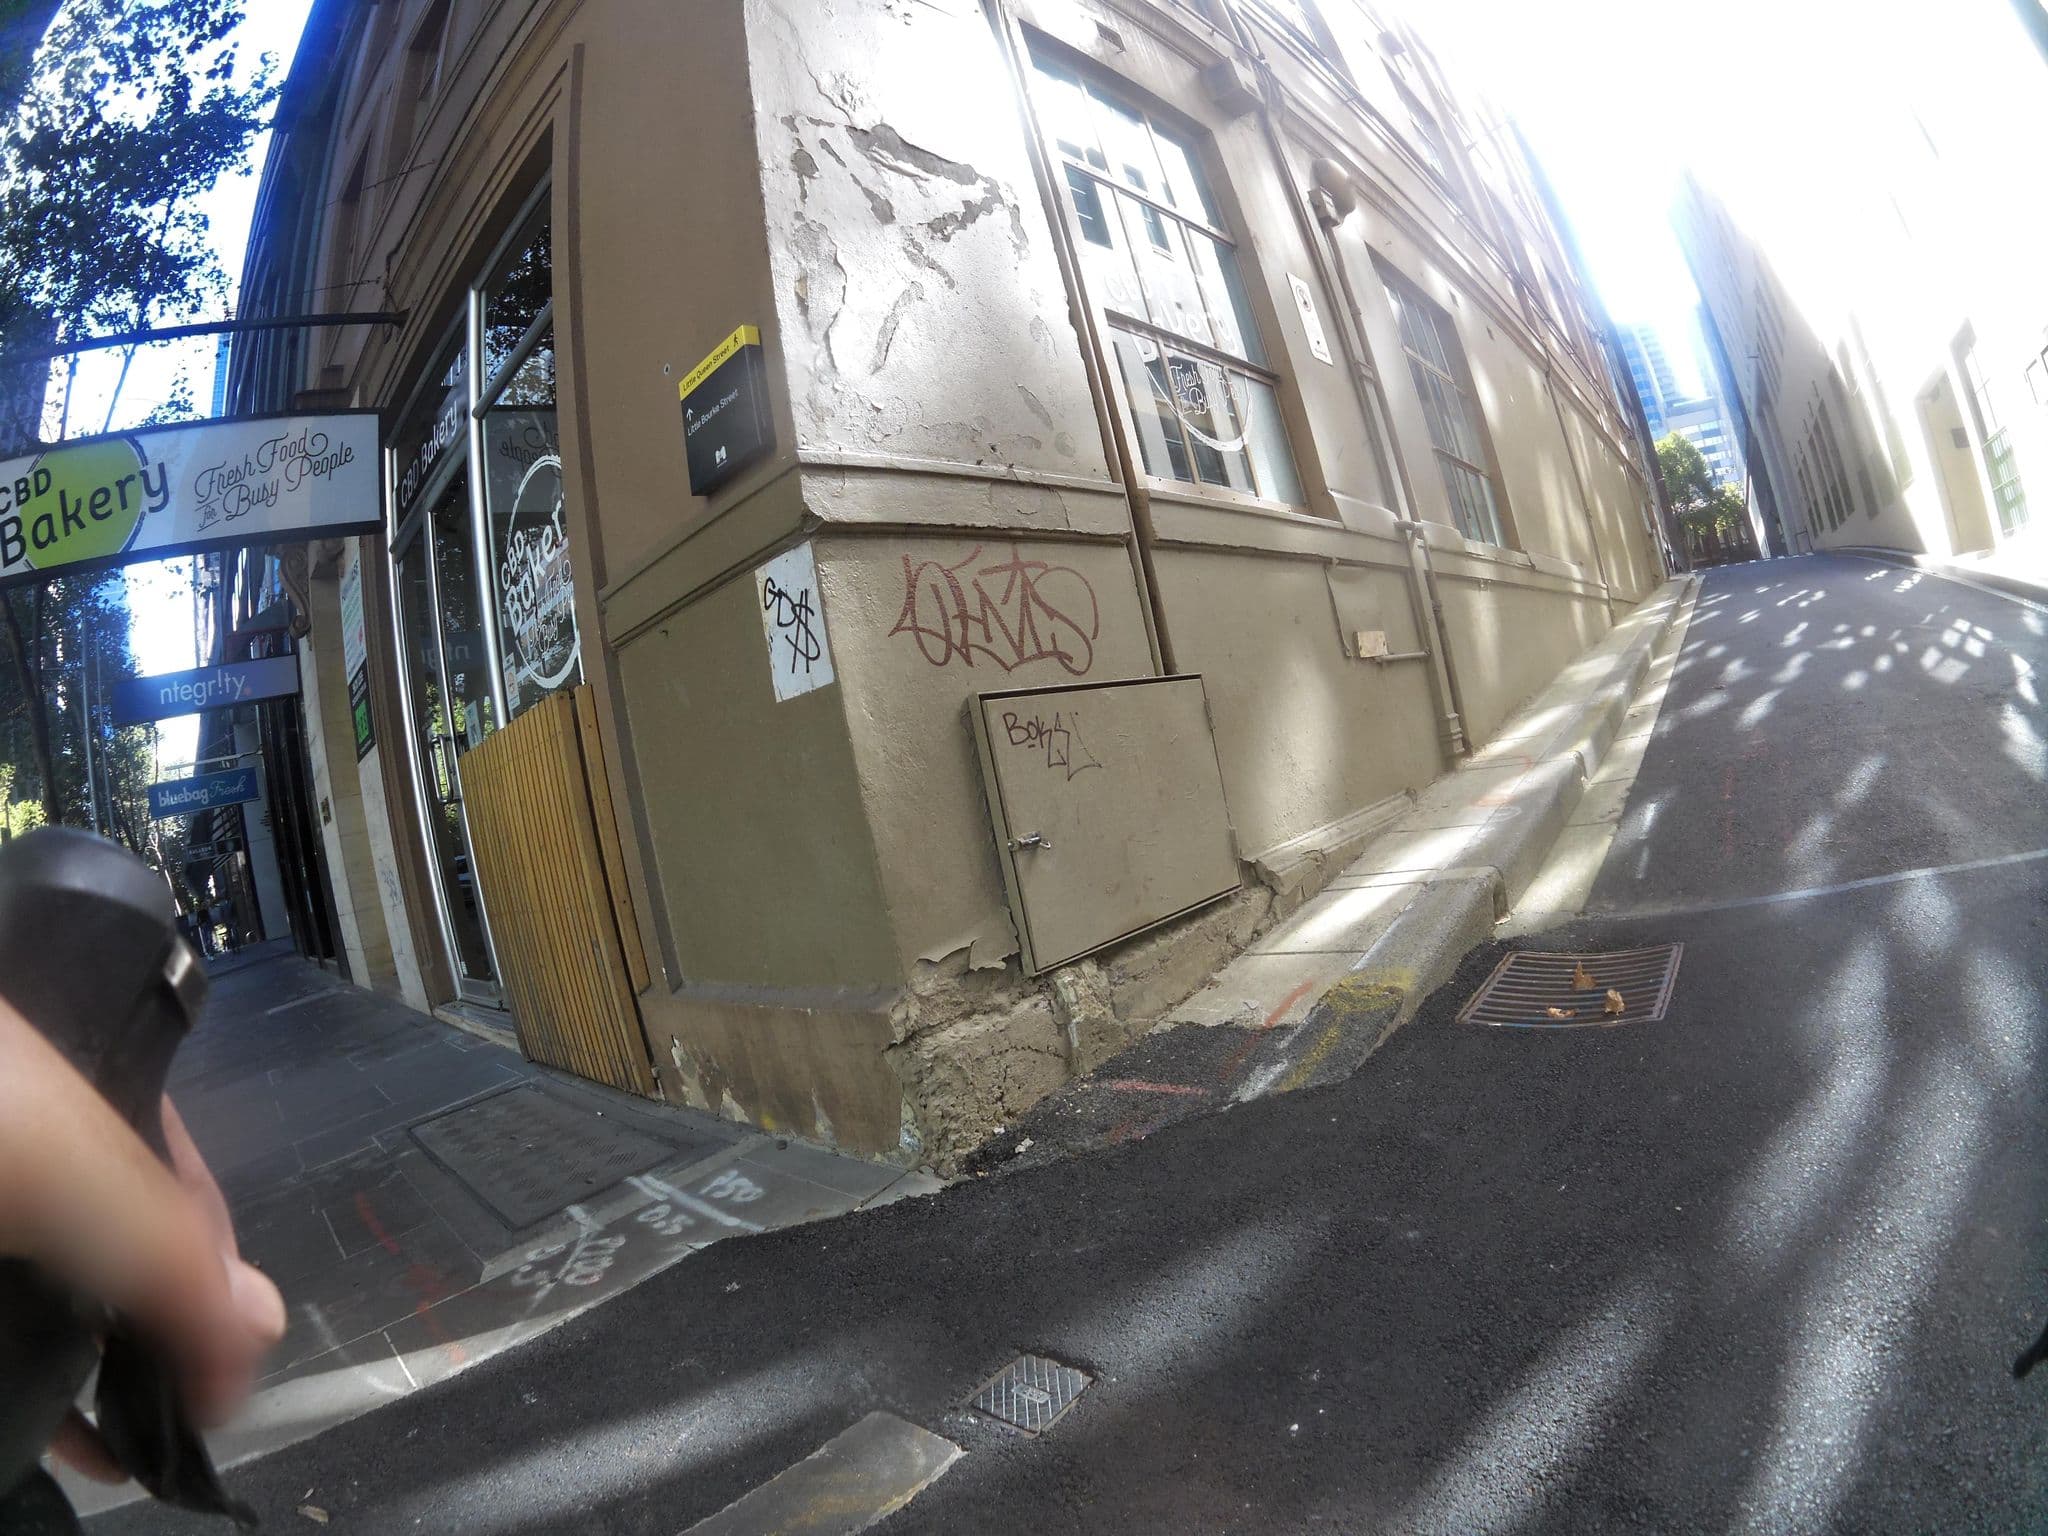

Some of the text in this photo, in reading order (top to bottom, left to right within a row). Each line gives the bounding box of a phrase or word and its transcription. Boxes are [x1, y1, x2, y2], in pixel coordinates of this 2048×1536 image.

[683, 345, 729, 392] Little Queen Street
[688, 388, 738, 436] Little Bourke Street
[194, 427, 328, 504] Fresh Food
[222, 478, 280, 522] Busy
[284, 441, 355, 493] People
[401, 400, 458, 508] CBD Bakery
[0, 467, 52, 516] CBD
[0, 462, 170, 569] Bakery
[501, 529, 525, 591] CBD
[504, 496, 566, 637] Baker
[158, 786, 209, 806] bluebag
